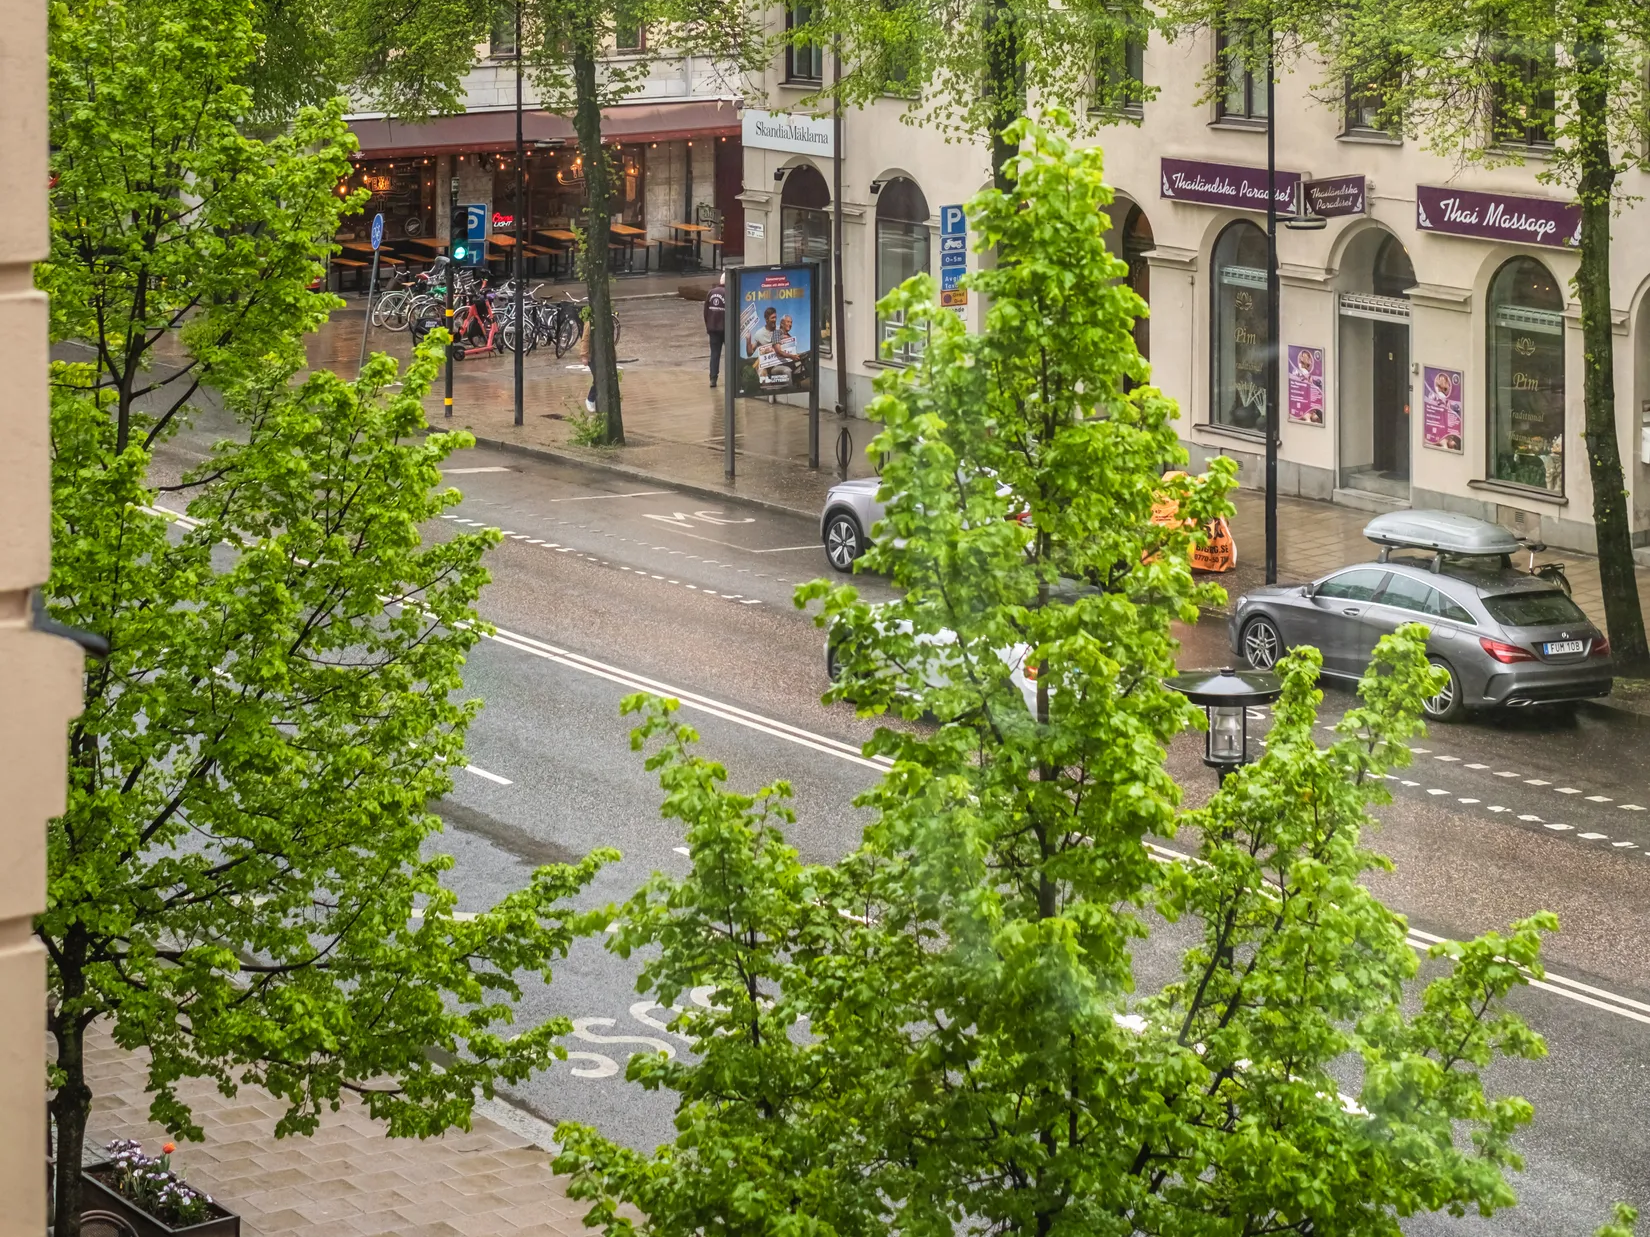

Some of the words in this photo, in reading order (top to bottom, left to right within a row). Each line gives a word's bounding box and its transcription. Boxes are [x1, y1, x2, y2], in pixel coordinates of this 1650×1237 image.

[755, 121, 829, 144] SkandiaMäklarna
[1172, 172, 1236, 195] Thailändska
[1310, 185, 1358, 198] Thailändska
[1316, 197, 1353, 210] Paradiset
[947, 208, 961, 233] P
[1439, 198, 1480, 224] Thai
[1482, 202, 1556, 242] Massage
[745, 291, 756, 302] 61
[1233, 327, 1256, 345] Pim
[1513, 372, 1539, 392] Pim
[1508, 408, 1545, 422] Traditional
[1550, 643, 1565, 652] FUM
